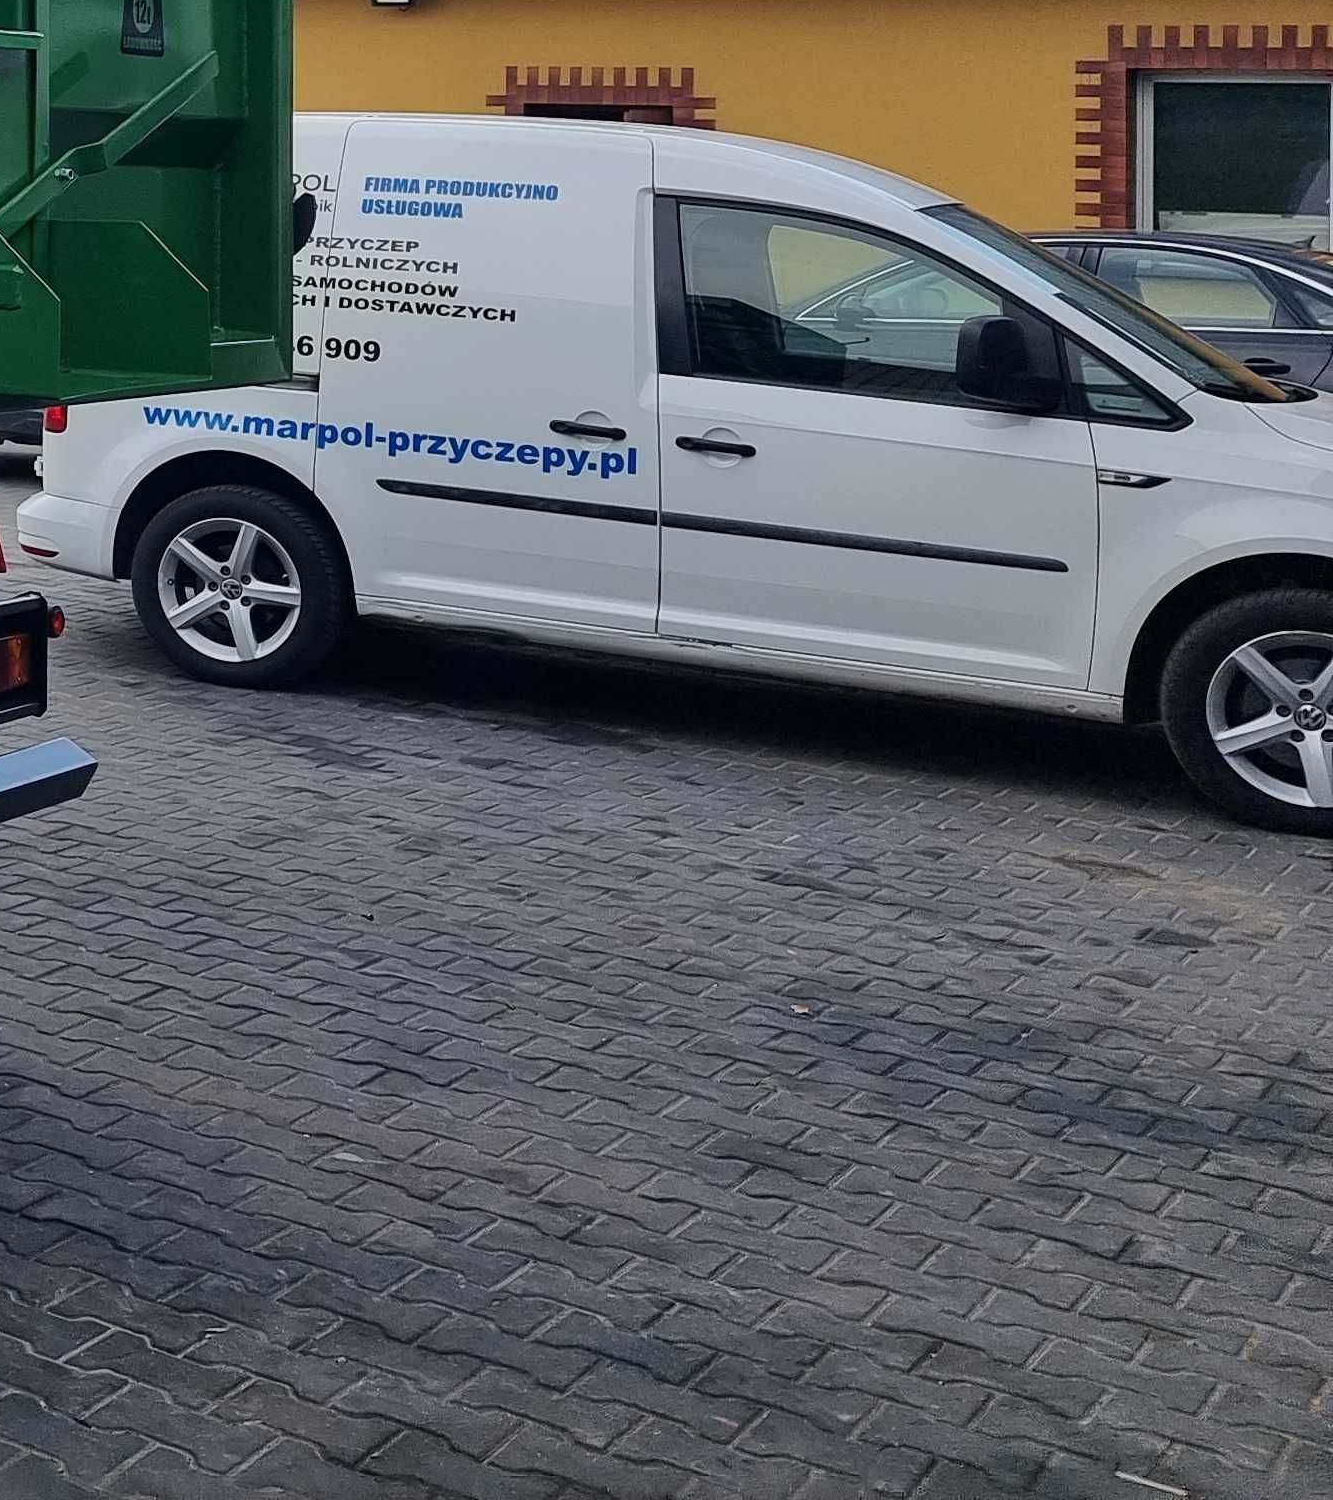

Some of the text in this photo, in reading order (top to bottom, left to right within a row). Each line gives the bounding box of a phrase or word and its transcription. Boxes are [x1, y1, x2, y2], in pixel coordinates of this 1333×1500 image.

[364, 176, 559, 201] FIRMA PRODUKCYJNO
[361, 198, 464, 219] USŁUGOWA
[310, 254, 459, 275] ROLNICZYCH
[293, 275, 459, 298] SAMOCHODÓW
[339, 296, 516, 323] DOSTAWCZYCH
[324, 337, 381, 362] 909
[143, 405, 638, 479] www.marpol-przyczepy.pl
